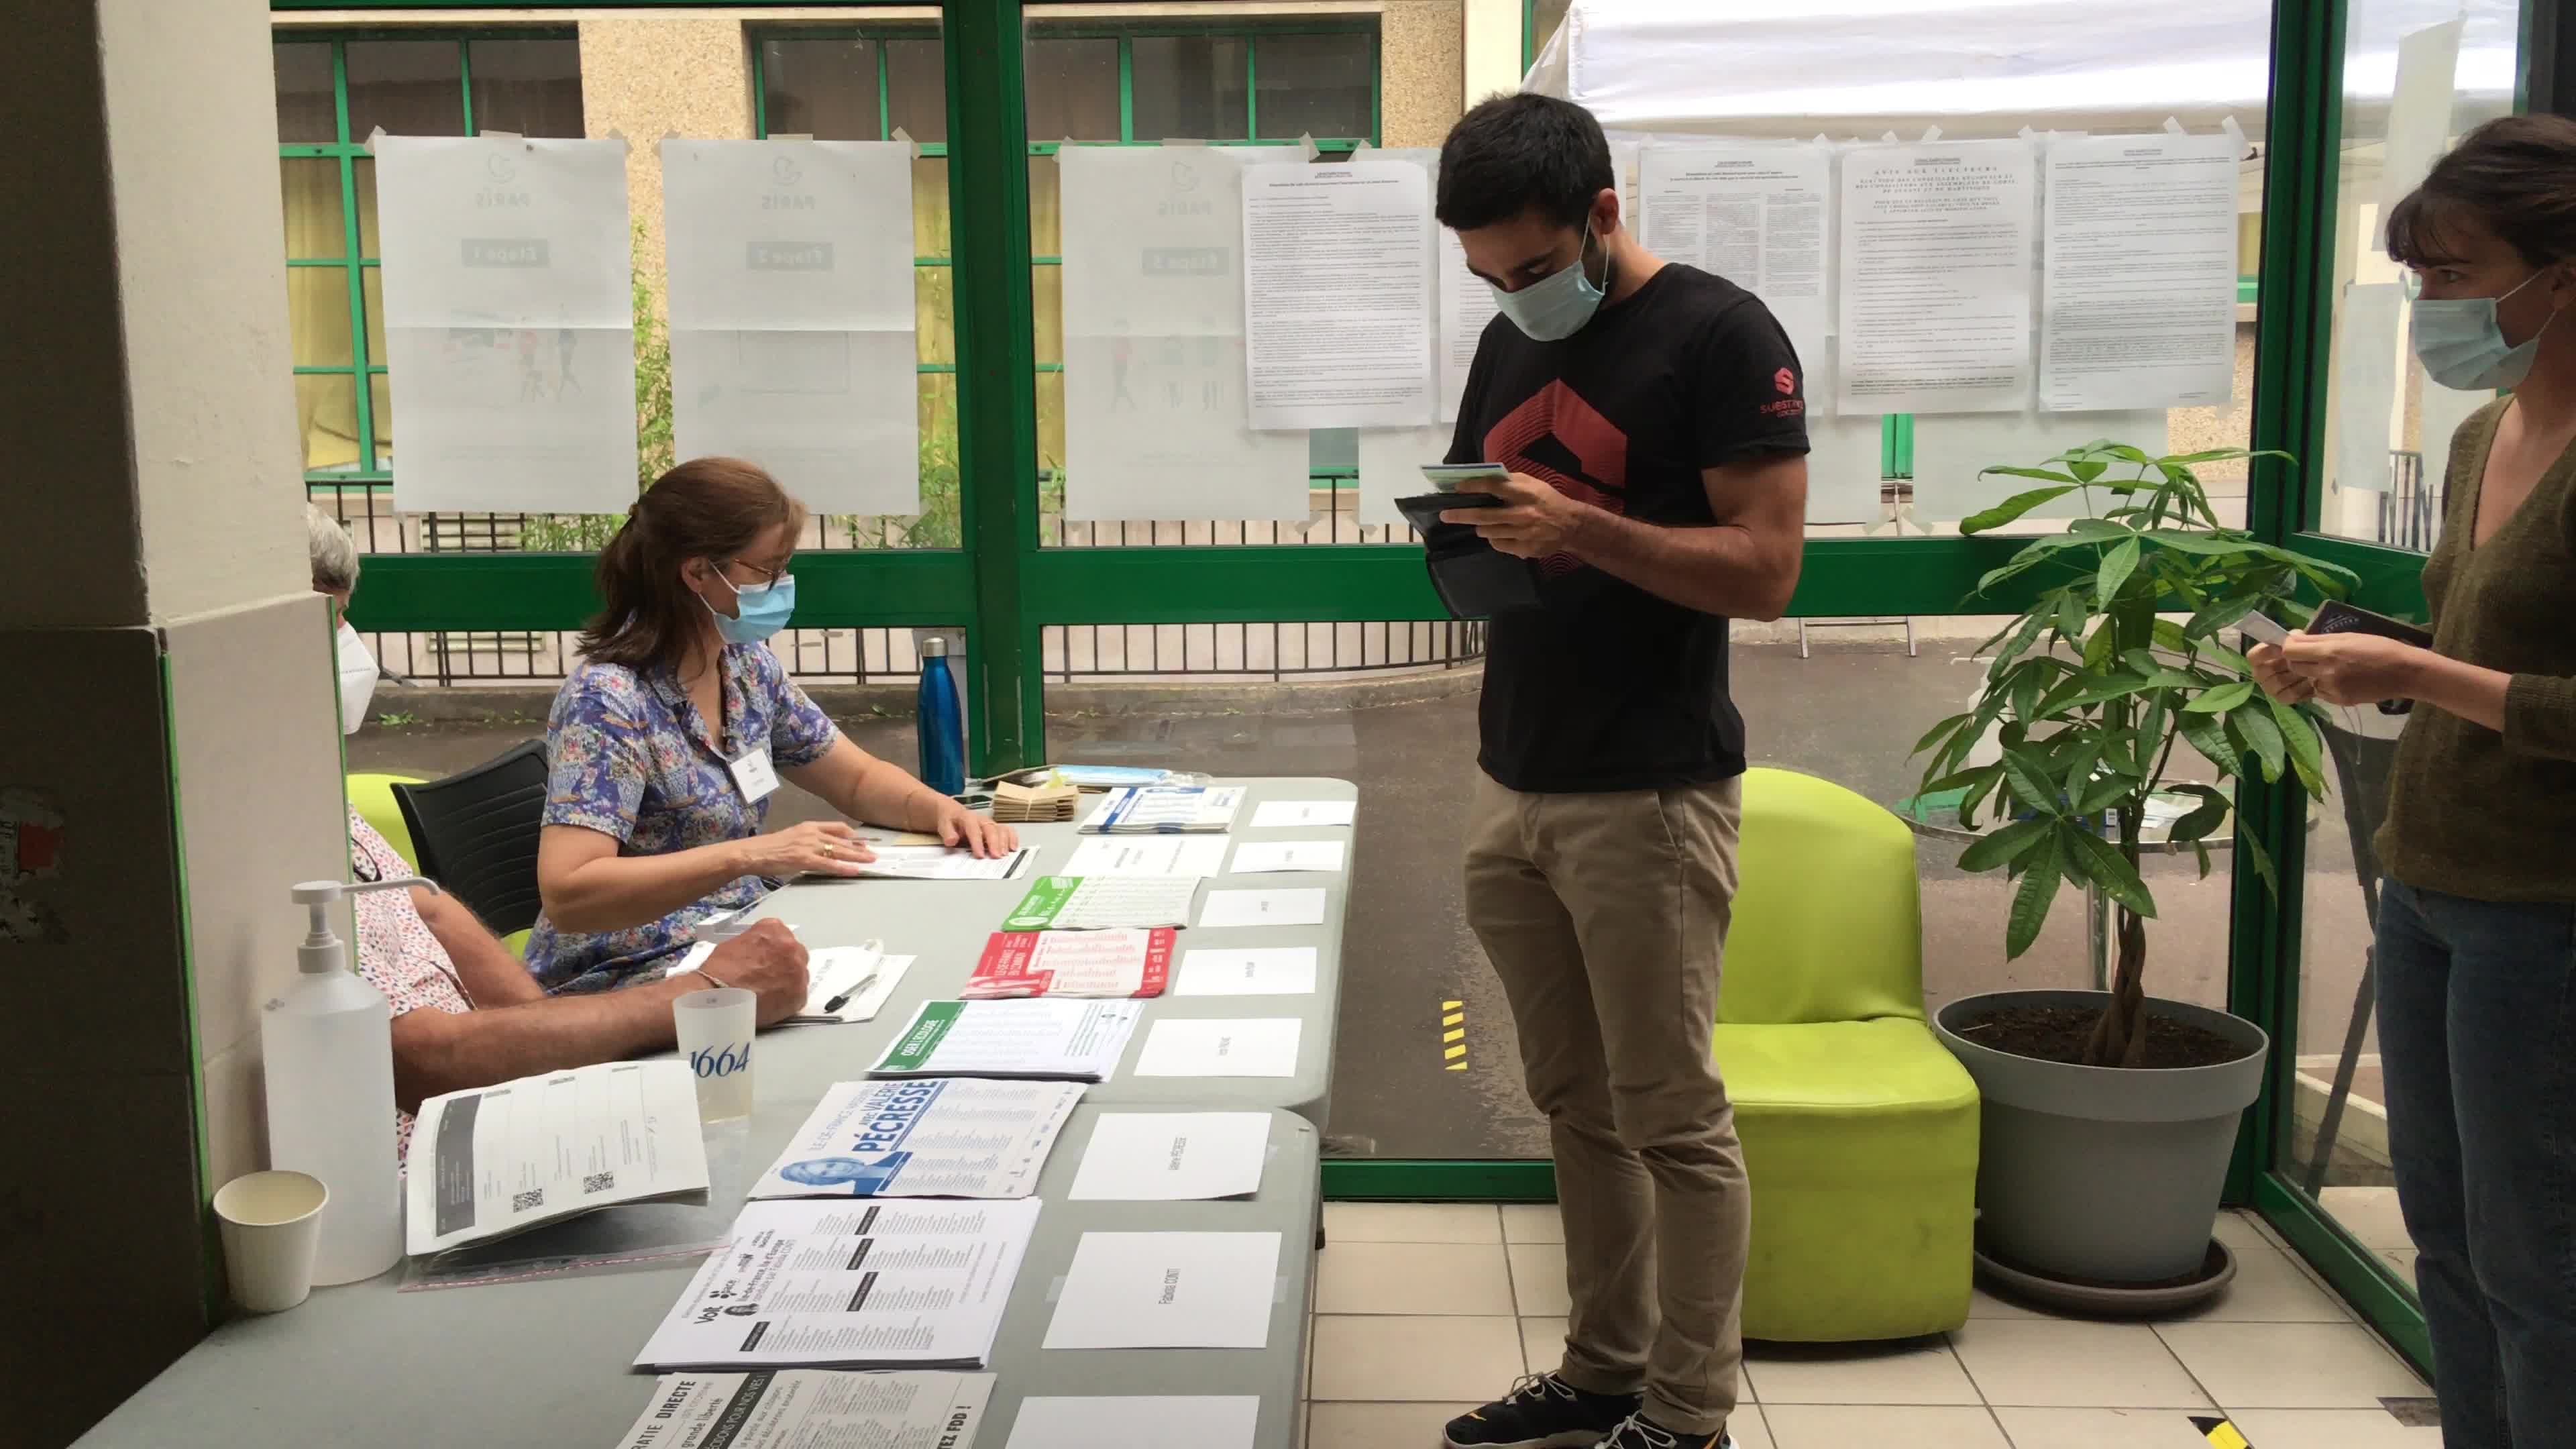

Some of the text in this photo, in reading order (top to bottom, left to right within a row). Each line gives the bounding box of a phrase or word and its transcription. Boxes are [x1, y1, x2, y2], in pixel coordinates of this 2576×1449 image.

[690, 1042, 750, 1078] 1664
[851, 1081, 939, 1152] PÉCRESSE
[693, 1305, 723, 1324] Volt
[655, 1381, 697, 1419] DIRECTE
[681, 1397, 724, 1448] grande liberté
[946, 1413, 967, 1432] FDD
